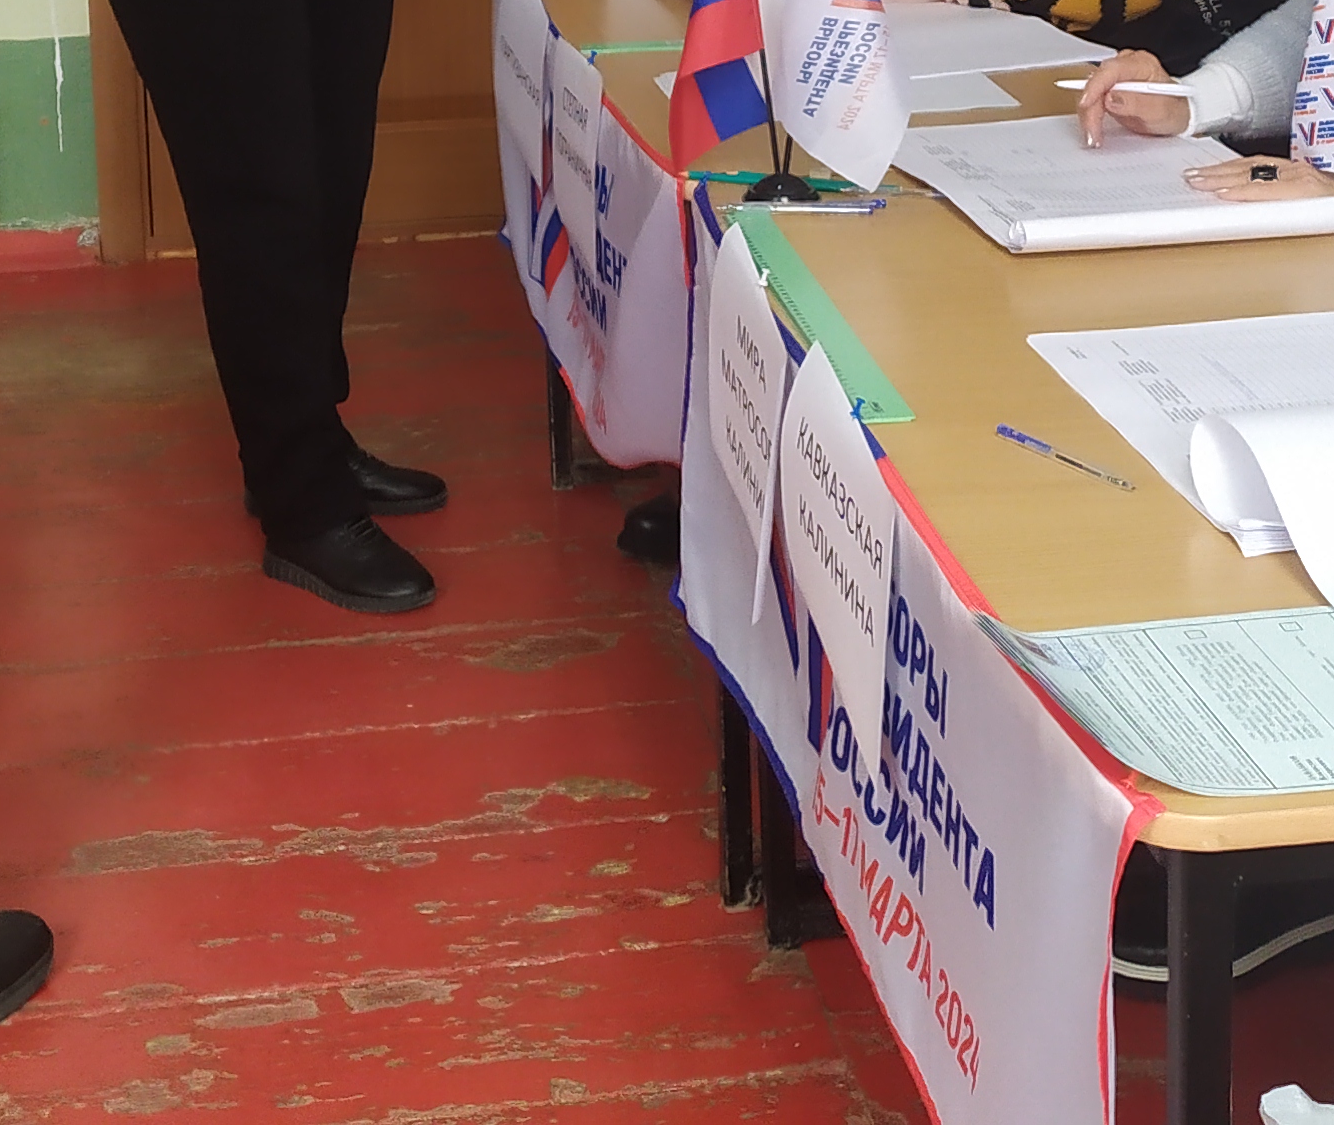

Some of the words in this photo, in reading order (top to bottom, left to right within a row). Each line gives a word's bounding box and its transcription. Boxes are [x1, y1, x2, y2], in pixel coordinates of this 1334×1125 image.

[736, 314, 767, 394] МИРА
[796, 416, 884, 579] КАВКАЗСКАЯ
[798, 493, 875, 648] КАЛИНИНА
[858, 840, 932, 1001] МАРТА
[934, 967, 981, 1096] 2024
